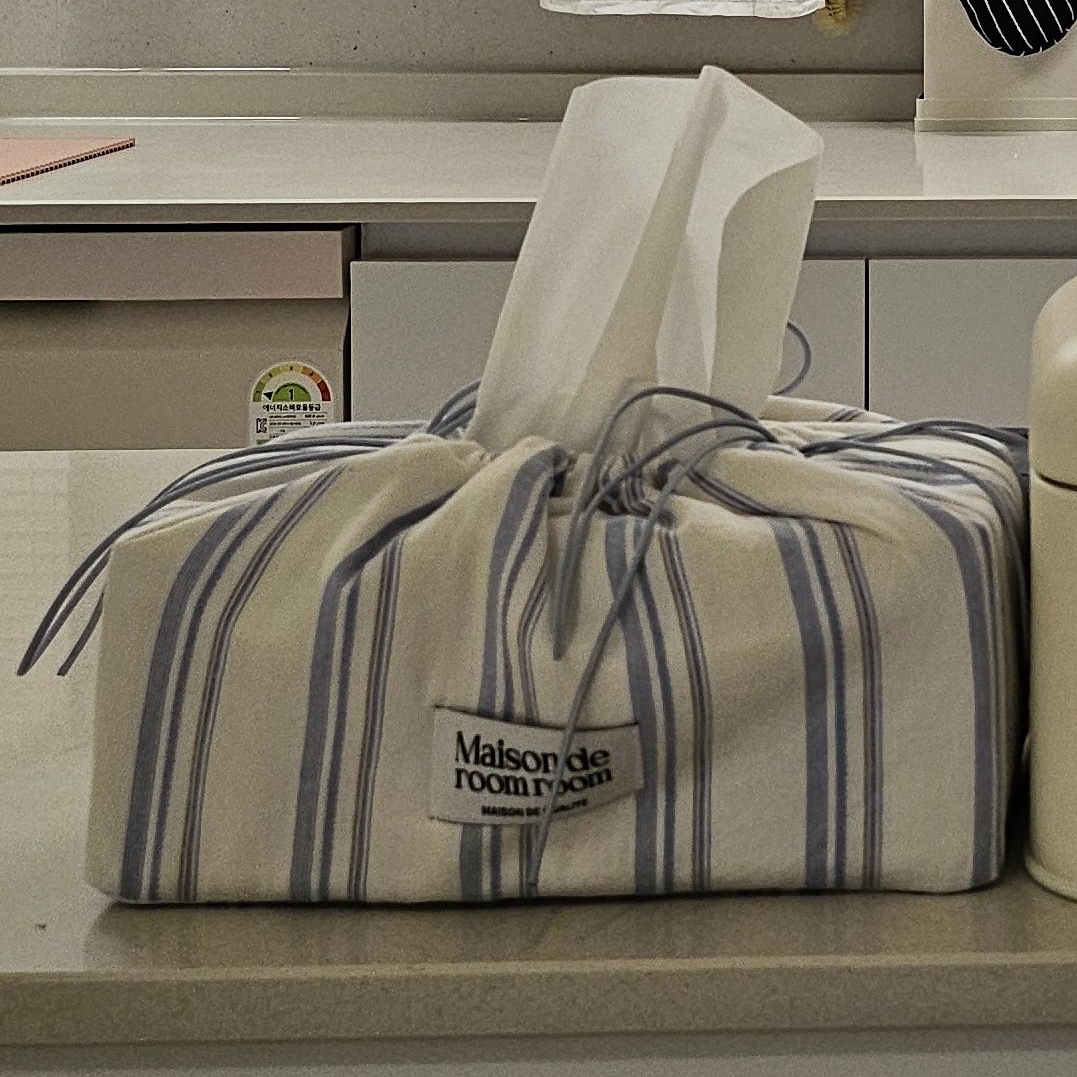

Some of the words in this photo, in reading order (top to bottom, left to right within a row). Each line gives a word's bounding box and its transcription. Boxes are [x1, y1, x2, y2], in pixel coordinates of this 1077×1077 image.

[288, 388, 294, 401] 1
[454, 730, 558, 774] Maison
[566, 747, 611, 772] de
[454, 767, 530, 797] room
